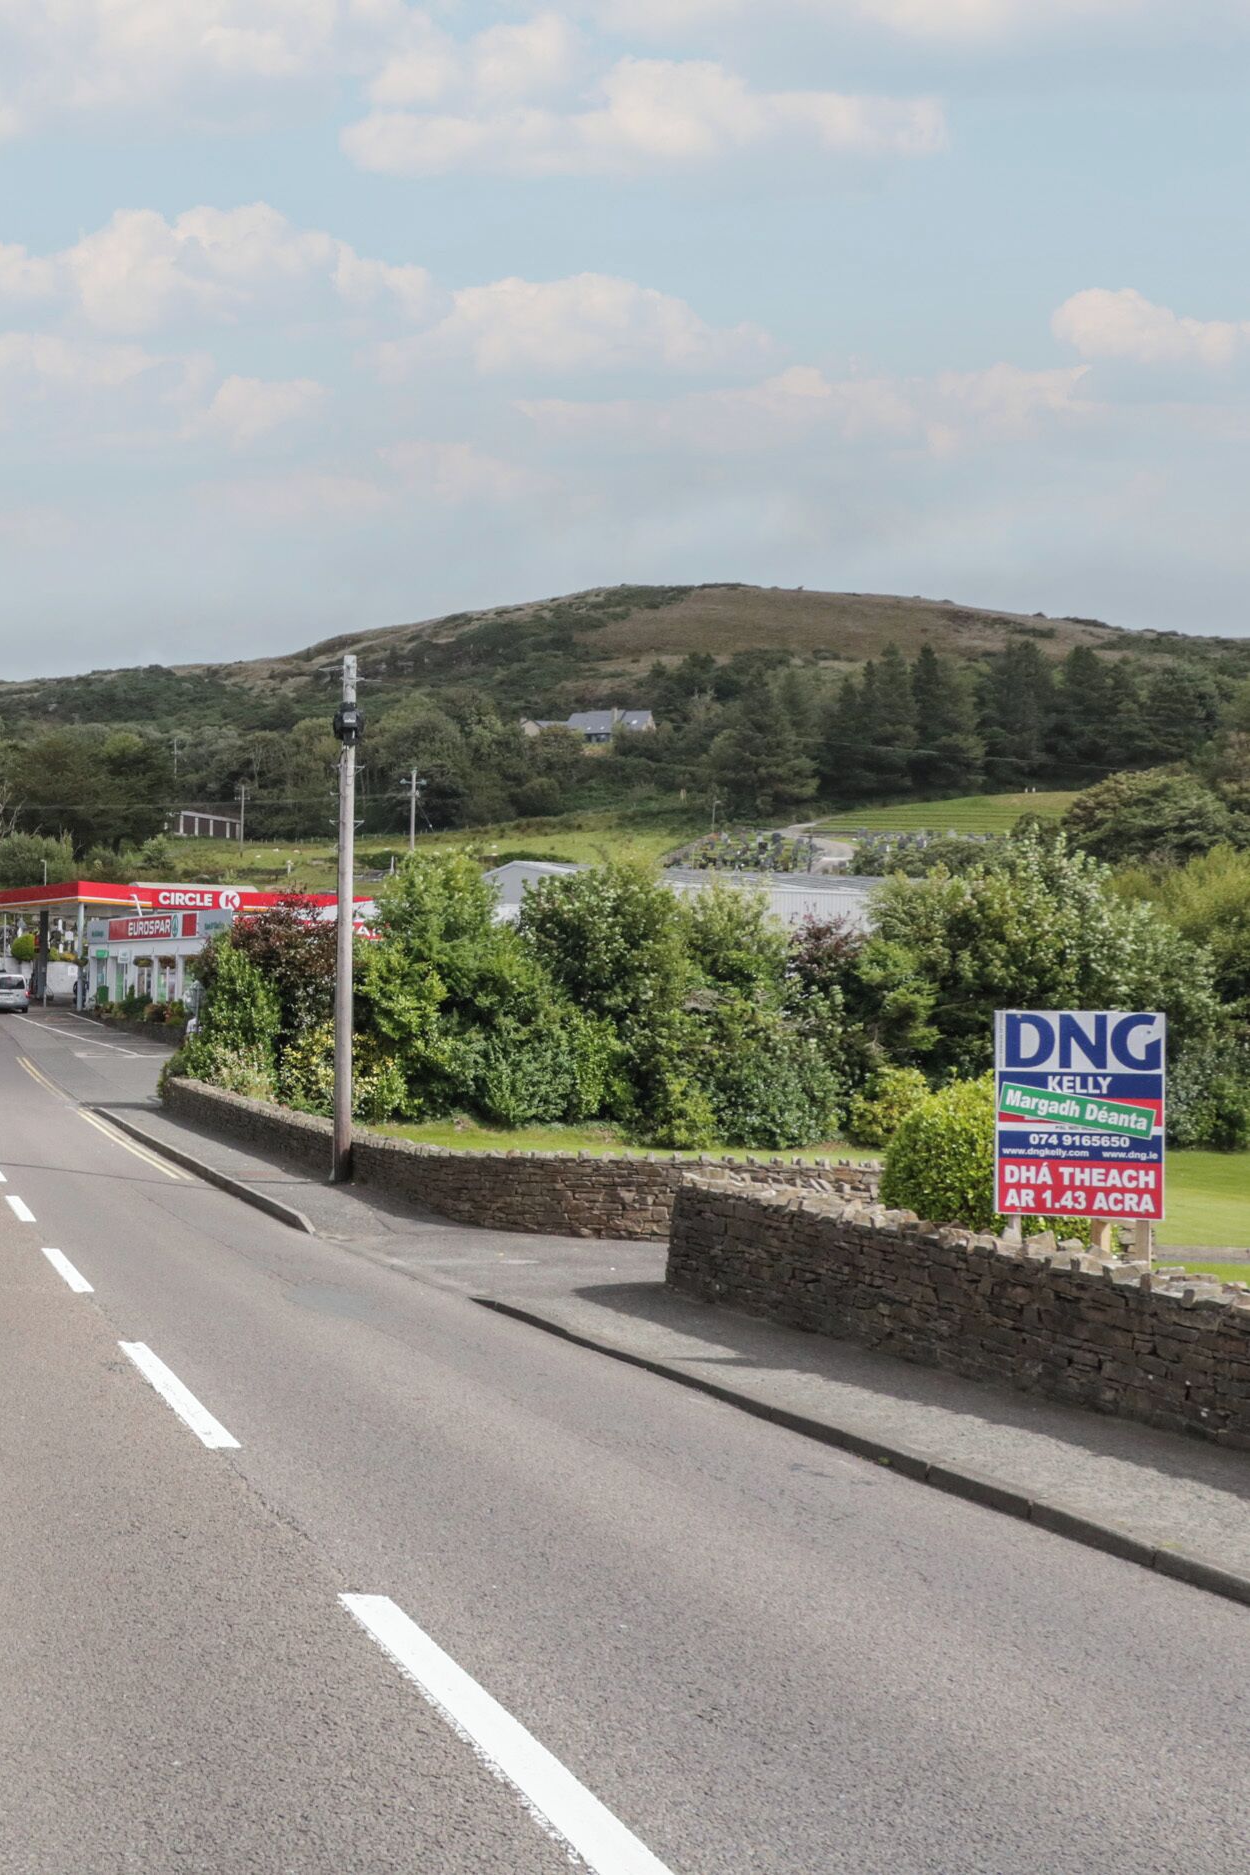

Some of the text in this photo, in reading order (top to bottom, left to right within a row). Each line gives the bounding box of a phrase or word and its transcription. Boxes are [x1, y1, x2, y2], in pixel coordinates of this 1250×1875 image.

[158, 891, 239, 910] CIRCLE K
[128, 919, 171, 936] EUROSPAR
[1005, 1013, 1162, 1071] DNG
[1047, 1075, 1112, 1094] KELLY
[1005, 1089, 1148, 1130] Margadh Déanta
[1029, 1133, 1130, 1148] 074 9165650
[1002, 1147, 1158, 1161] www.dngkelly.com www.dng.ie
[1004, 1162, 1155, 1189] DHÁ THEACH
[1004, 1188, 1155, 1213] AR 1.43 ACRA
